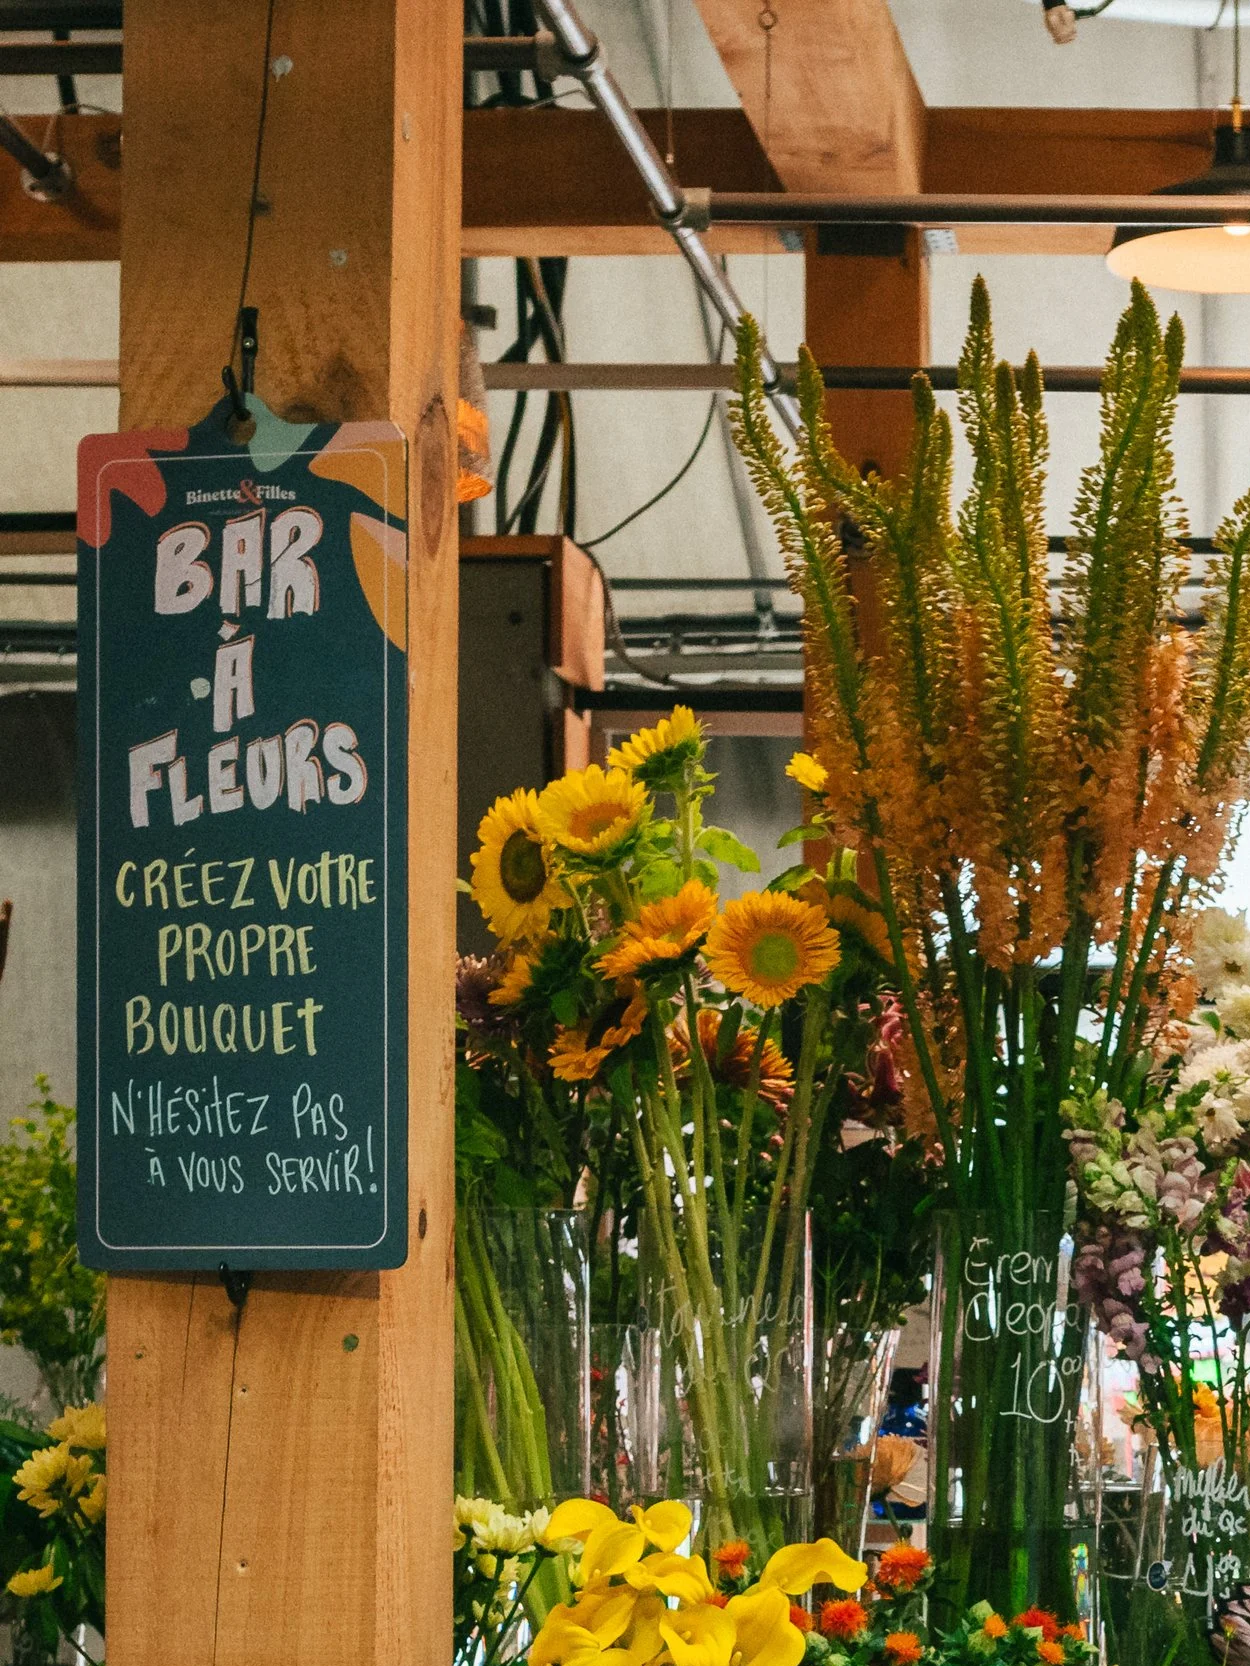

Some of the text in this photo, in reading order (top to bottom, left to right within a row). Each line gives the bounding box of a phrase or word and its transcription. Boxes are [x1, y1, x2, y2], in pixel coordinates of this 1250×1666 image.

[154, 506, 324, 620] BAR
[212, 621, 255, 733] À
[128, 718, 368, 828] FLEURS
[115, 848, 255, 910] CRÉEZ
[158, 923, 317, 986] PROPRE
[125, 995, 324, 1057] BOUQUET
[292, 1082, 348, 1141] PAS
[145, 1147, 166, 1187] À
[178, 1151, 245, 1195] VOUS
